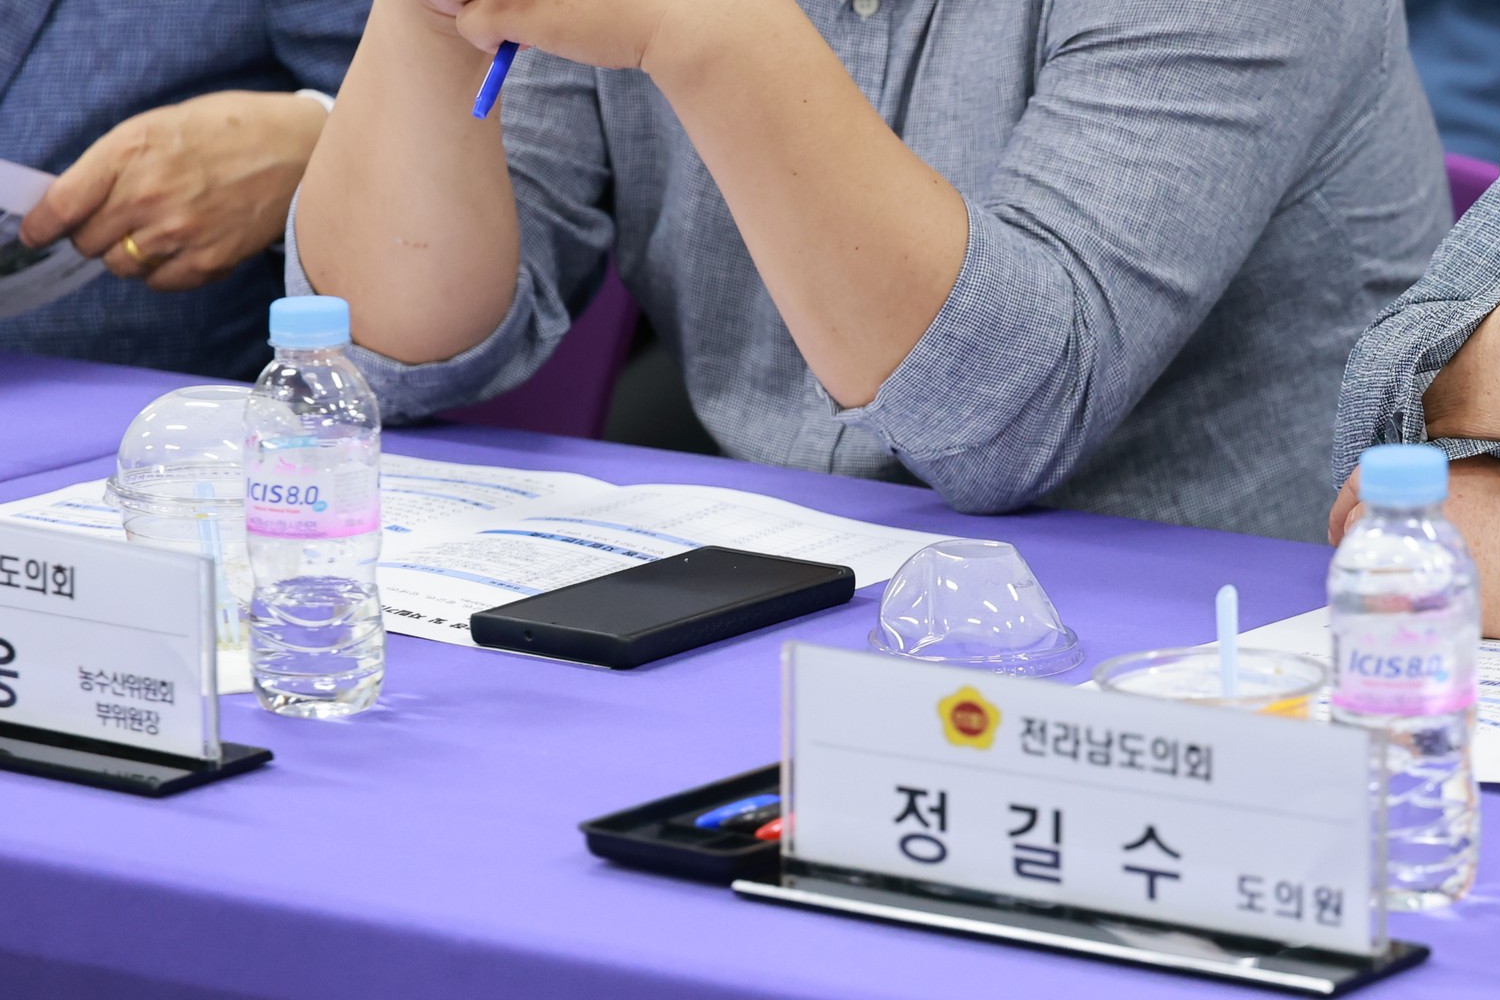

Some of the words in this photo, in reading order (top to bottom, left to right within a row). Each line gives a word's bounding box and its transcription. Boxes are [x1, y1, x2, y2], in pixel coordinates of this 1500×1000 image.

[0, 554, 76, 600] 도의회
[78, 665, 175, 705] 농수산위원회
[96, 702, 160, 736] 부위원장
[1020, 715, 1214, 783] 전라남도의회
[1237, 873, 1344, 928] 도의원
